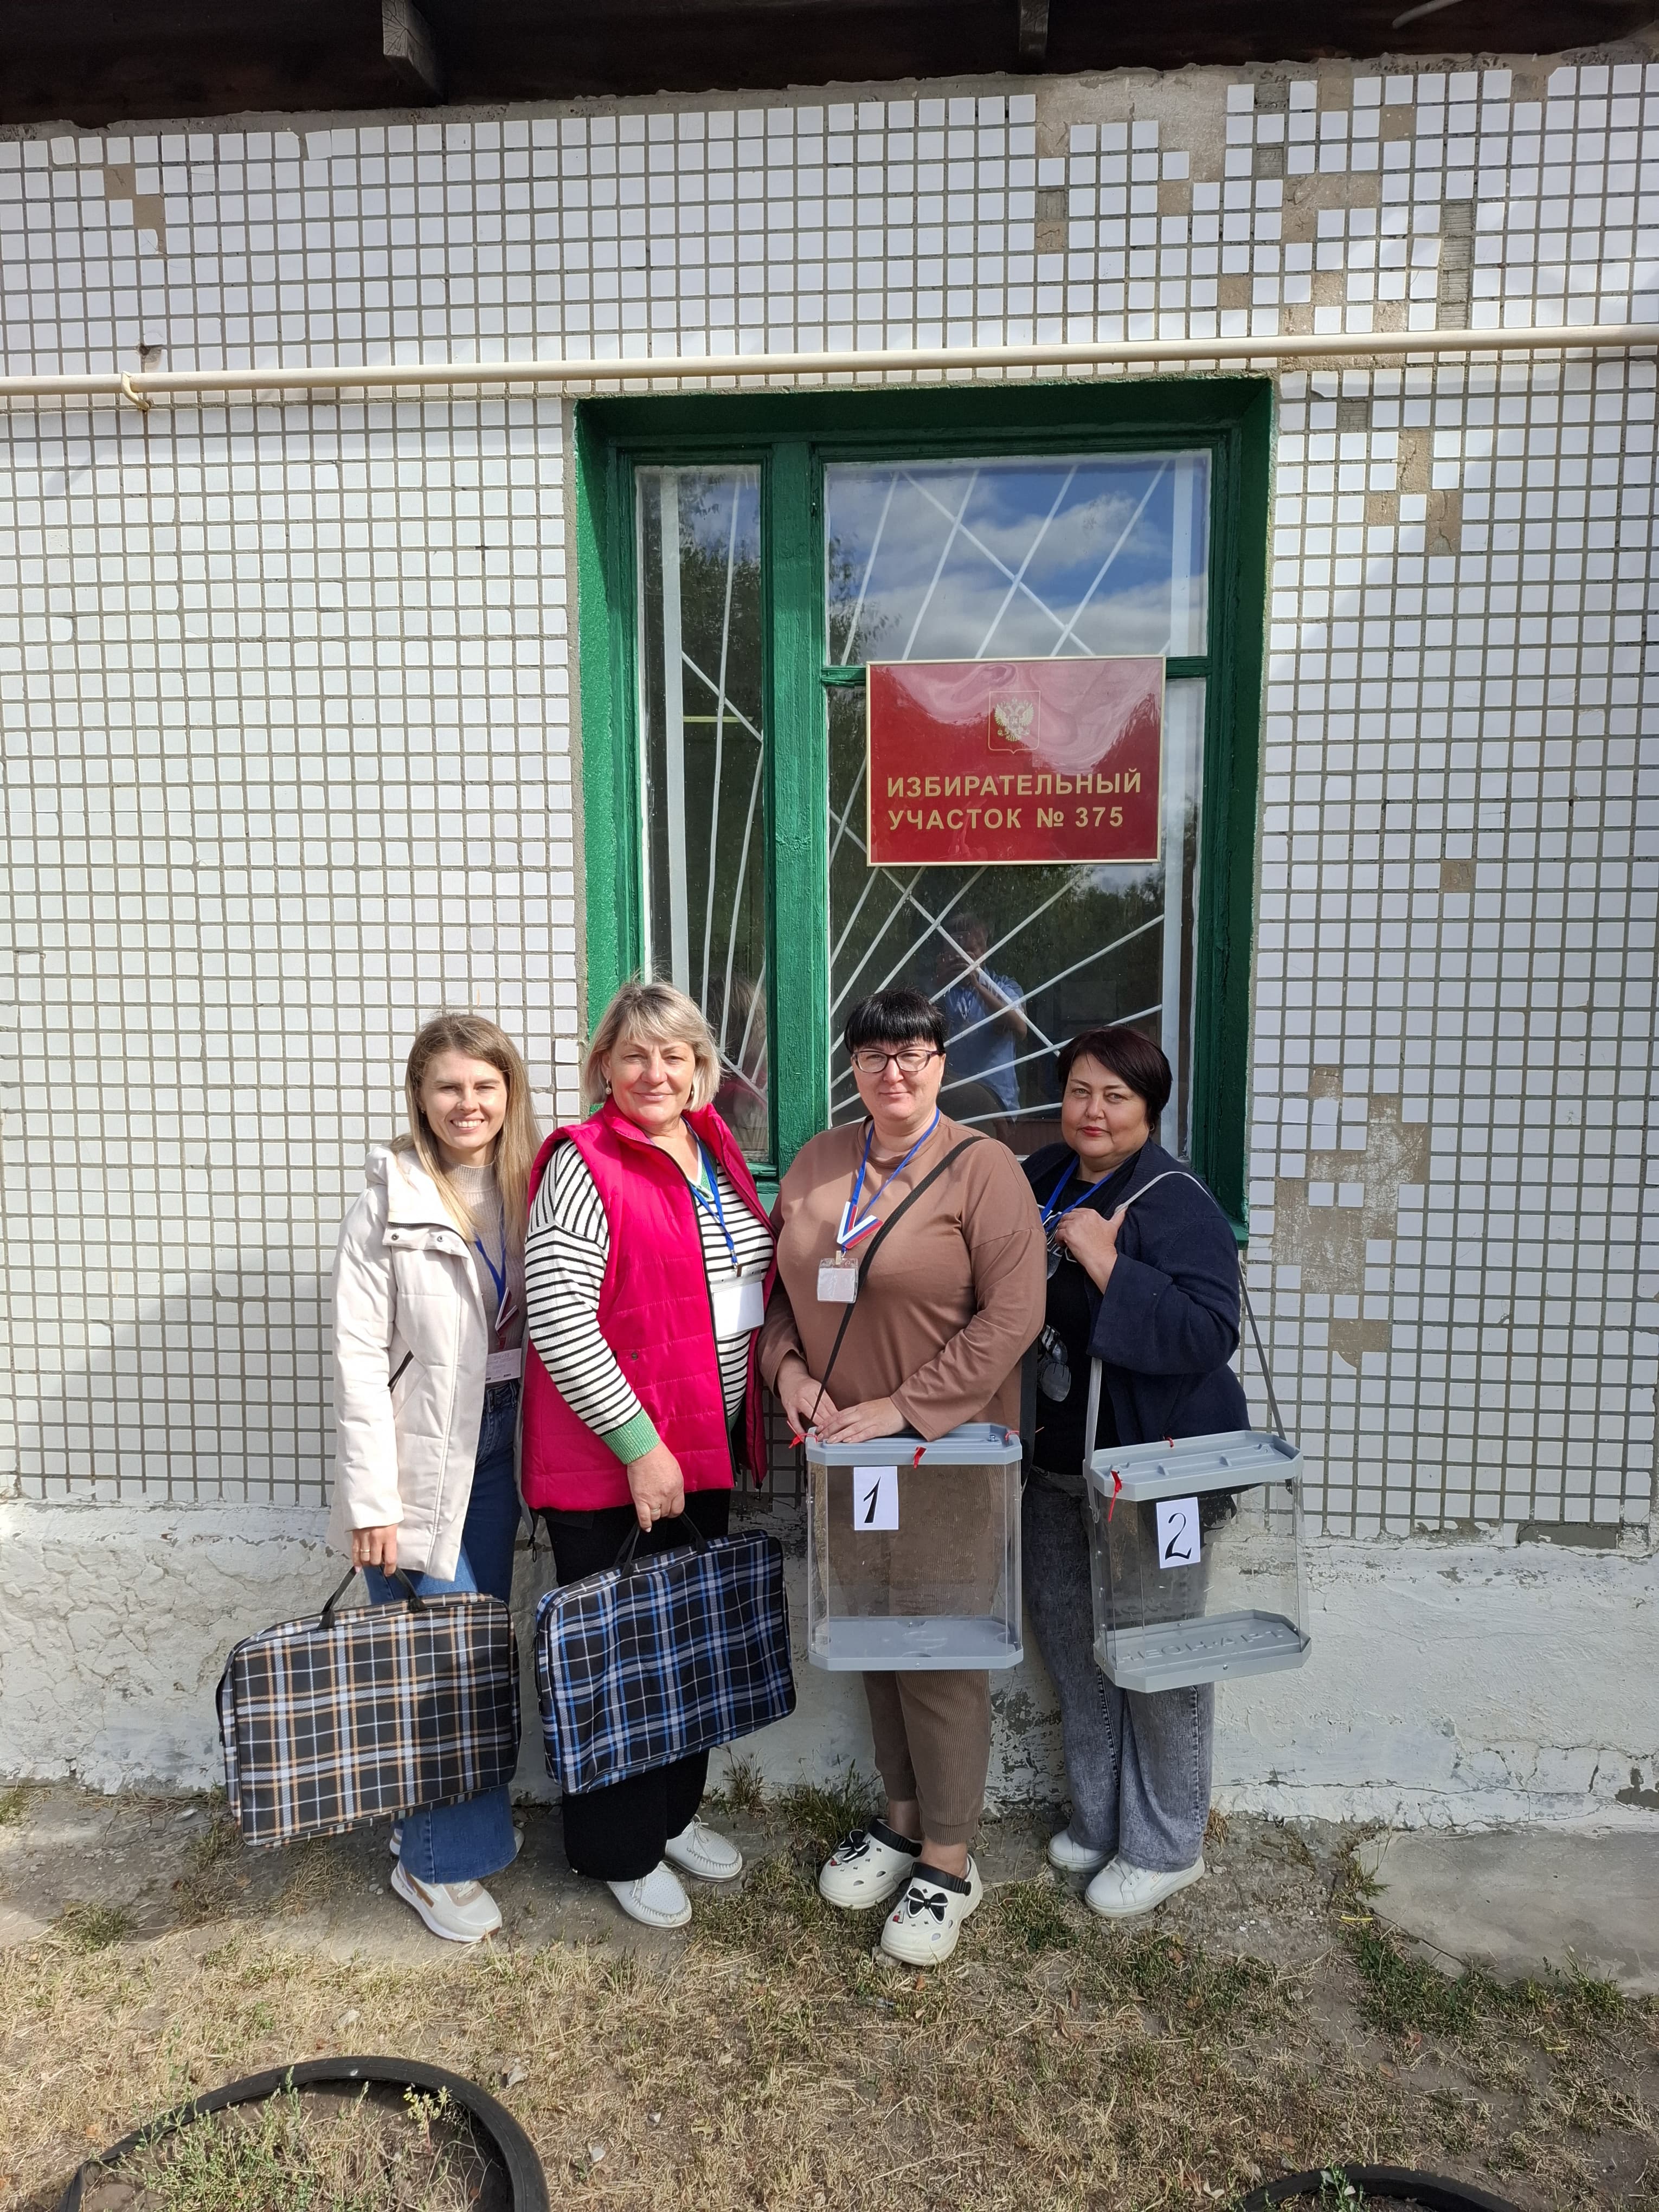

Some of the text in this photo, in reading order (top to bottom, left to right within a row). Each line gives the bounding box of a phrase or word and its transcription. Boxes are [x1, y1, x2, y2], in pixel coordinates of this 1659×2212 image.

[888, 768, 1141, 798] ИЗБИРАТЕЛЬНЫЙ
[888, 806, 1123, 830] УЧАСТОК № 375
[863, 1476, 881, 1523] 1
[1165, 1512, 1192, 1560] 2
